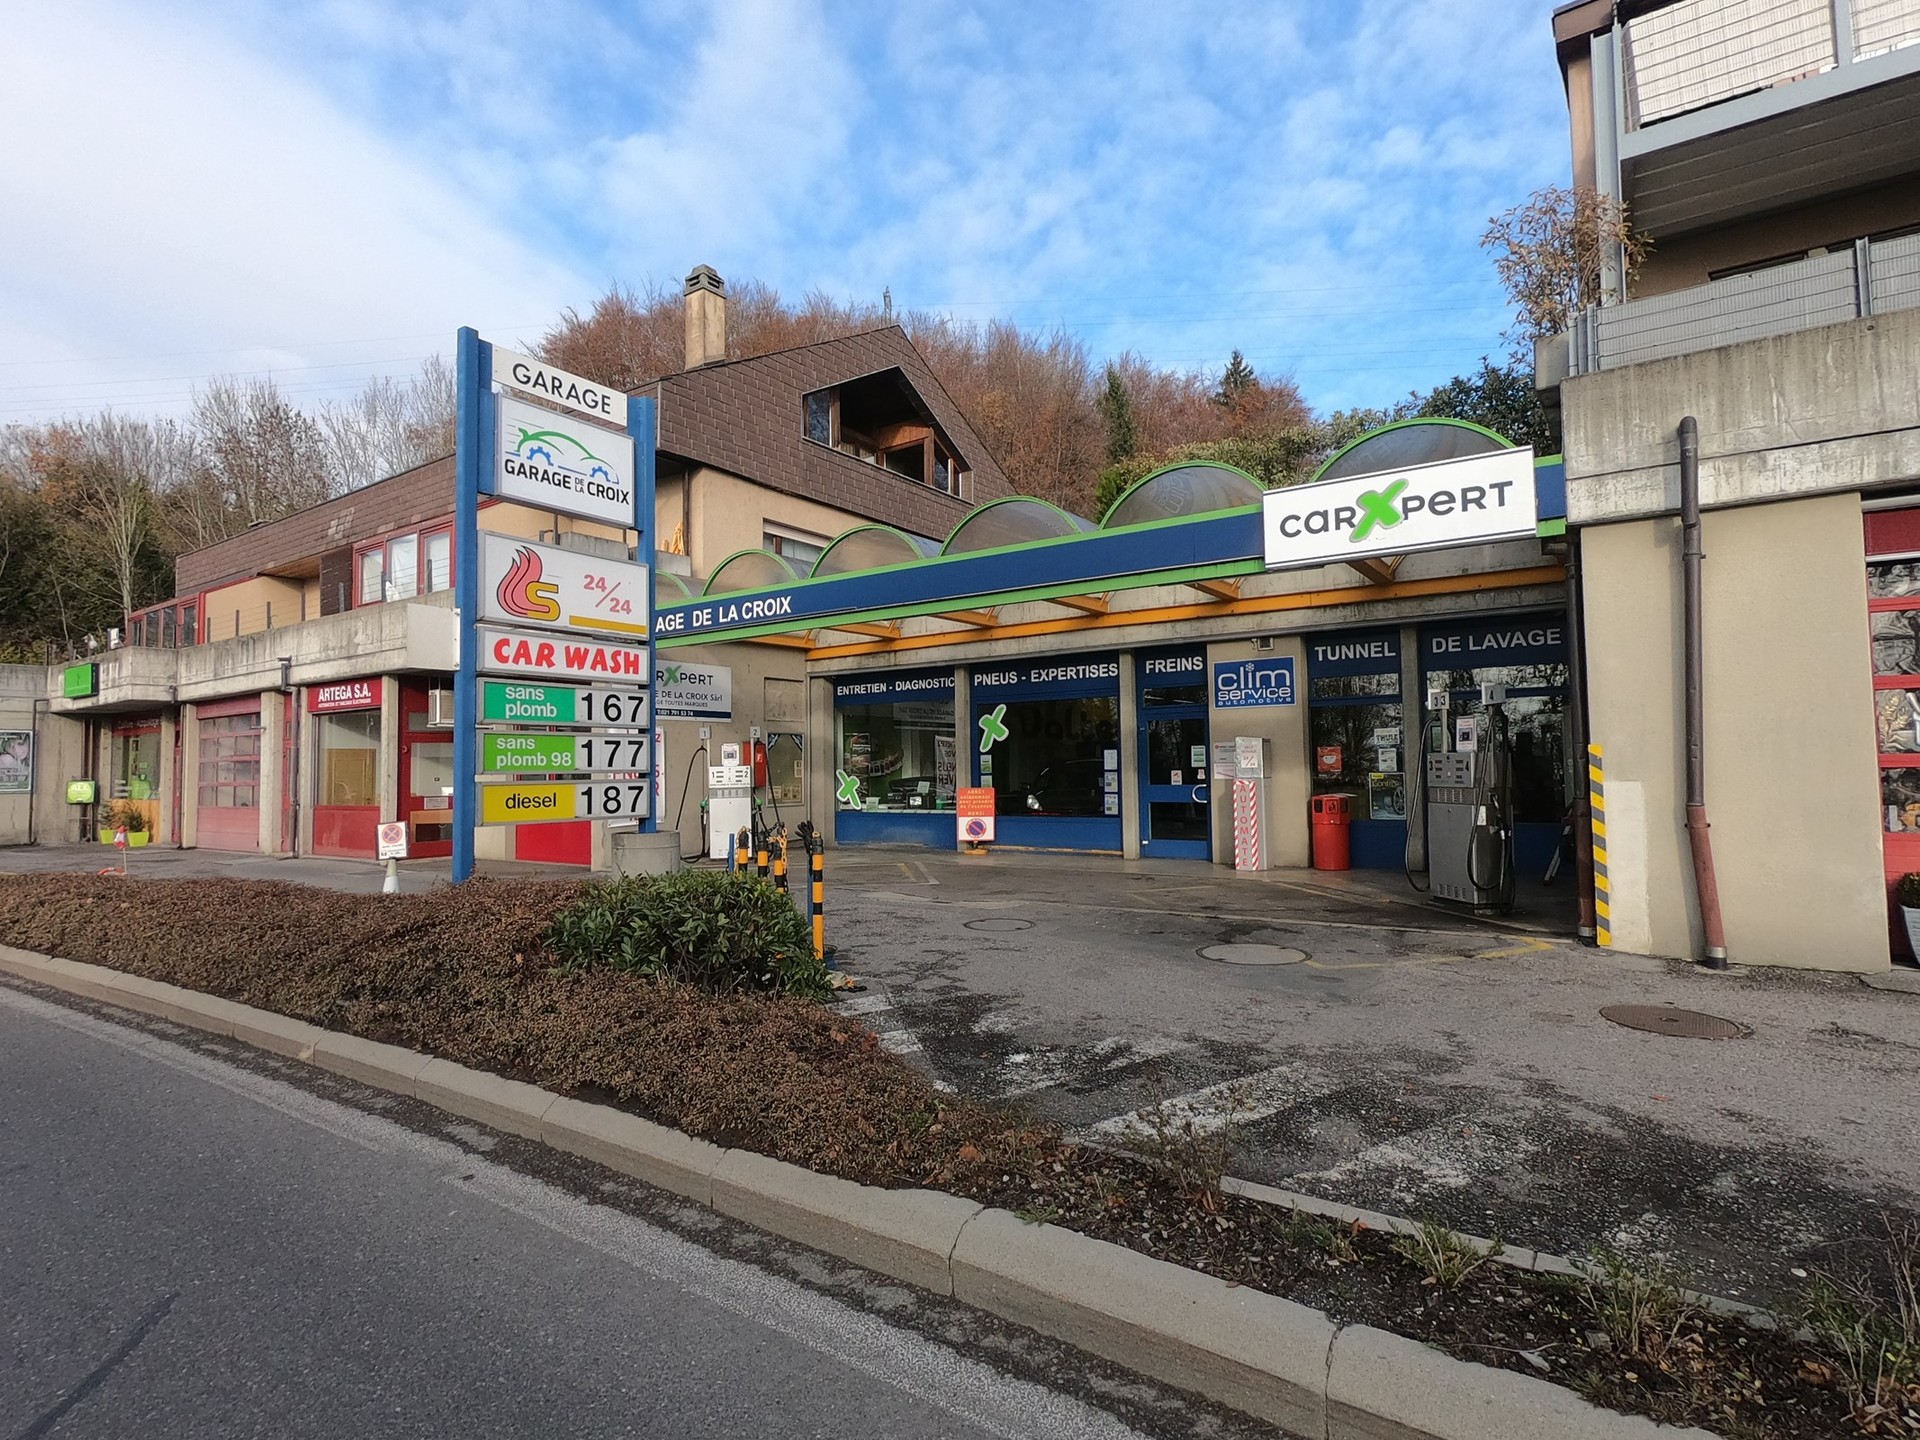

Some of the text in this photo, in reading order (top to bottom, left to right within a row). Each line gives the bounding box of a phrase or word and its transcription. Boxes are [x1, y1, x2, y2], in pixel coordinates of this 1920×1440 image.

[512, 362, 611, 415] GARAGE
[504, 458, 630, 505] GARAGE DE LA CROIX
[692, 608, 712, 627] DE
[719, 604, 738, 623] LA
[742, 596, 792, 620] CROIX
[1432, 628, 1561, 654] DE LAVAGE
[493, 638, 640, 675] CAR WASH
[1314, 642, 1396, 662] TUNNEL
[1145, 656, 1203, 674] FREINS
[974, 671, 1017, 687] PNEUS
[1030, 663, 1118, 683] EXPERTISES
[1217, 662, 1290, 690] clim
[318, 682, 371, 702] ARTEGA S.A.
[505, 686, 545, 700] sans
[661, 690, 672, 699] DE
[674, 691, 683, 699] LA
[685, 692, 709, 701] CROIX
[837, 682, 887, 696] ENTRETIEN
[895, 677, 955, 691] DIAGNOSTIC
[1217, 686, 1291, 701] service
[1489, 690, 1494, 701] 4
[581, 692, 644, 723] 167
[1217, 697, 1292, 706] automotive
[1434, 696, 1439, 707] 3
[1440, 695, 1446, 706] 3
[505, 703, 557, 719] plomb
[496, 737, 536, 750] sans
[496, 752, 572, 769] plomb 98
[581, 739, 644, 768] 177
[505, 792, 557, 809] diesel
[581, 785, 644, 815] 187
[1239, 784, 1249, 867] AUTOMATE
